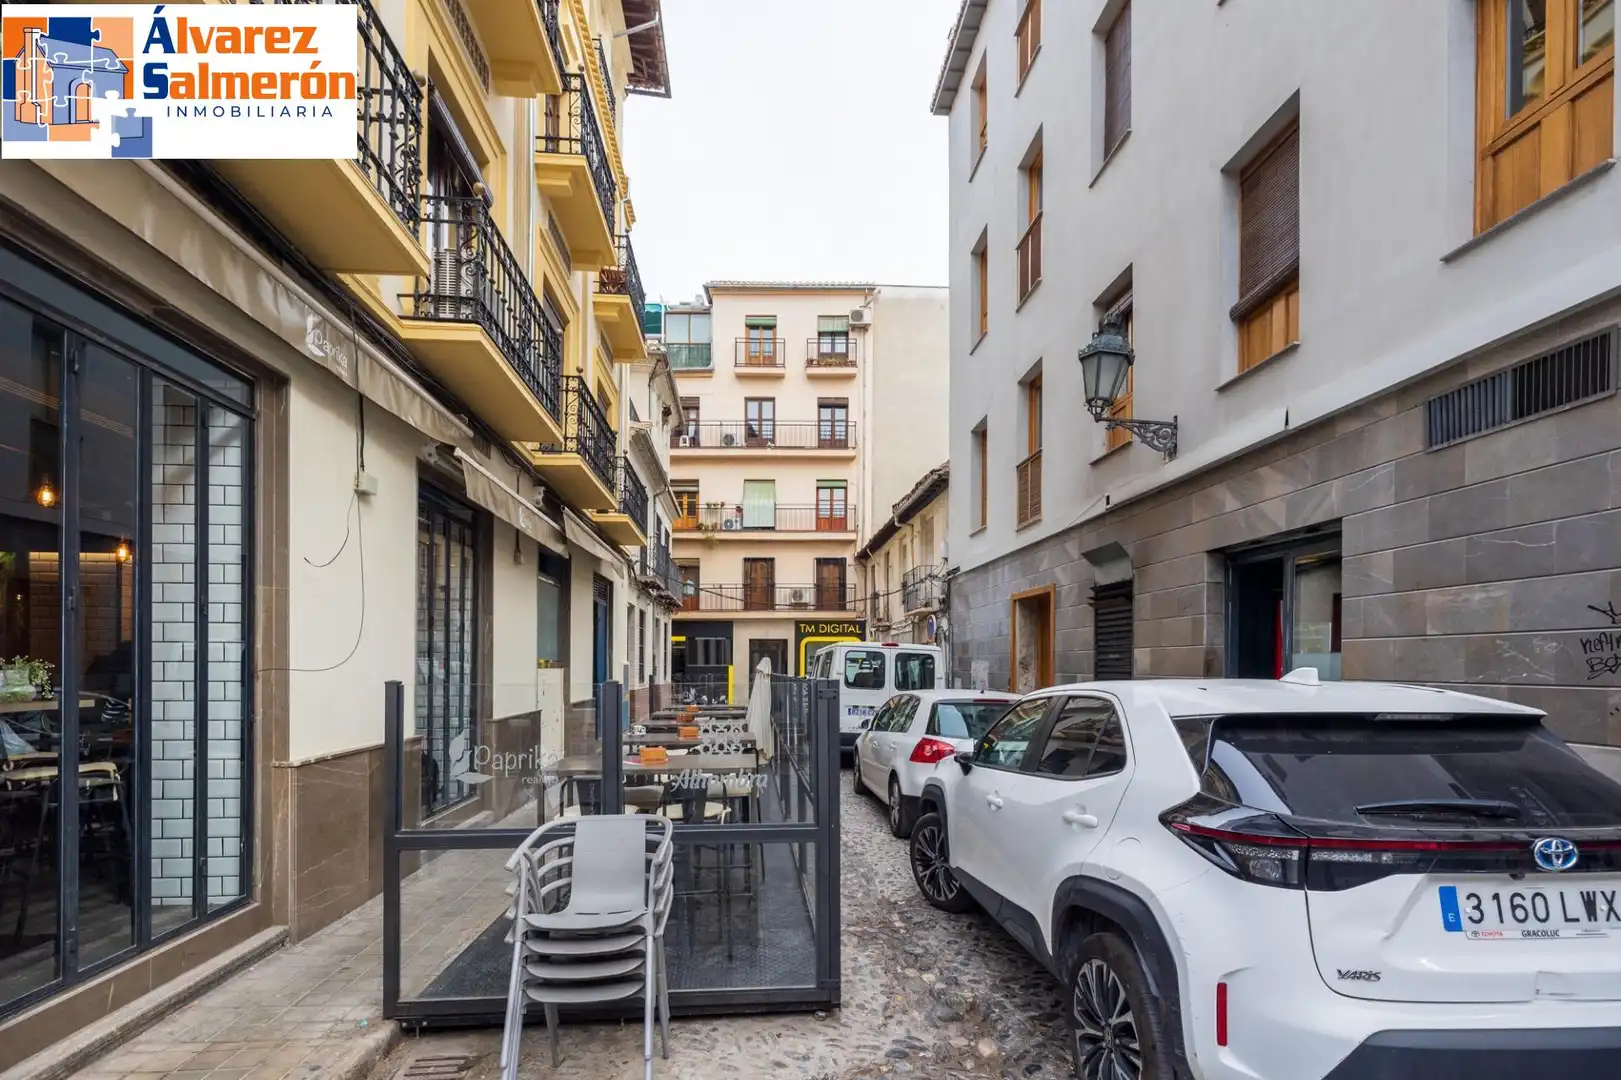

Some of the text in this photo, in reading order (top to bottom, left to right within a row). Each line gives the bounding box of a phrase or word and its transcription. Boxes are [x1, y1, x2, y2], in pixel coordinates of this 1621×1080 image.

[799, 623, 862, 634] TM DIGITAL
[1465, 891, 1550, 925] 3160
[1560, 890, 1621, 923] LWX
[1521, 929, 1560, 938] GRACOLUC
